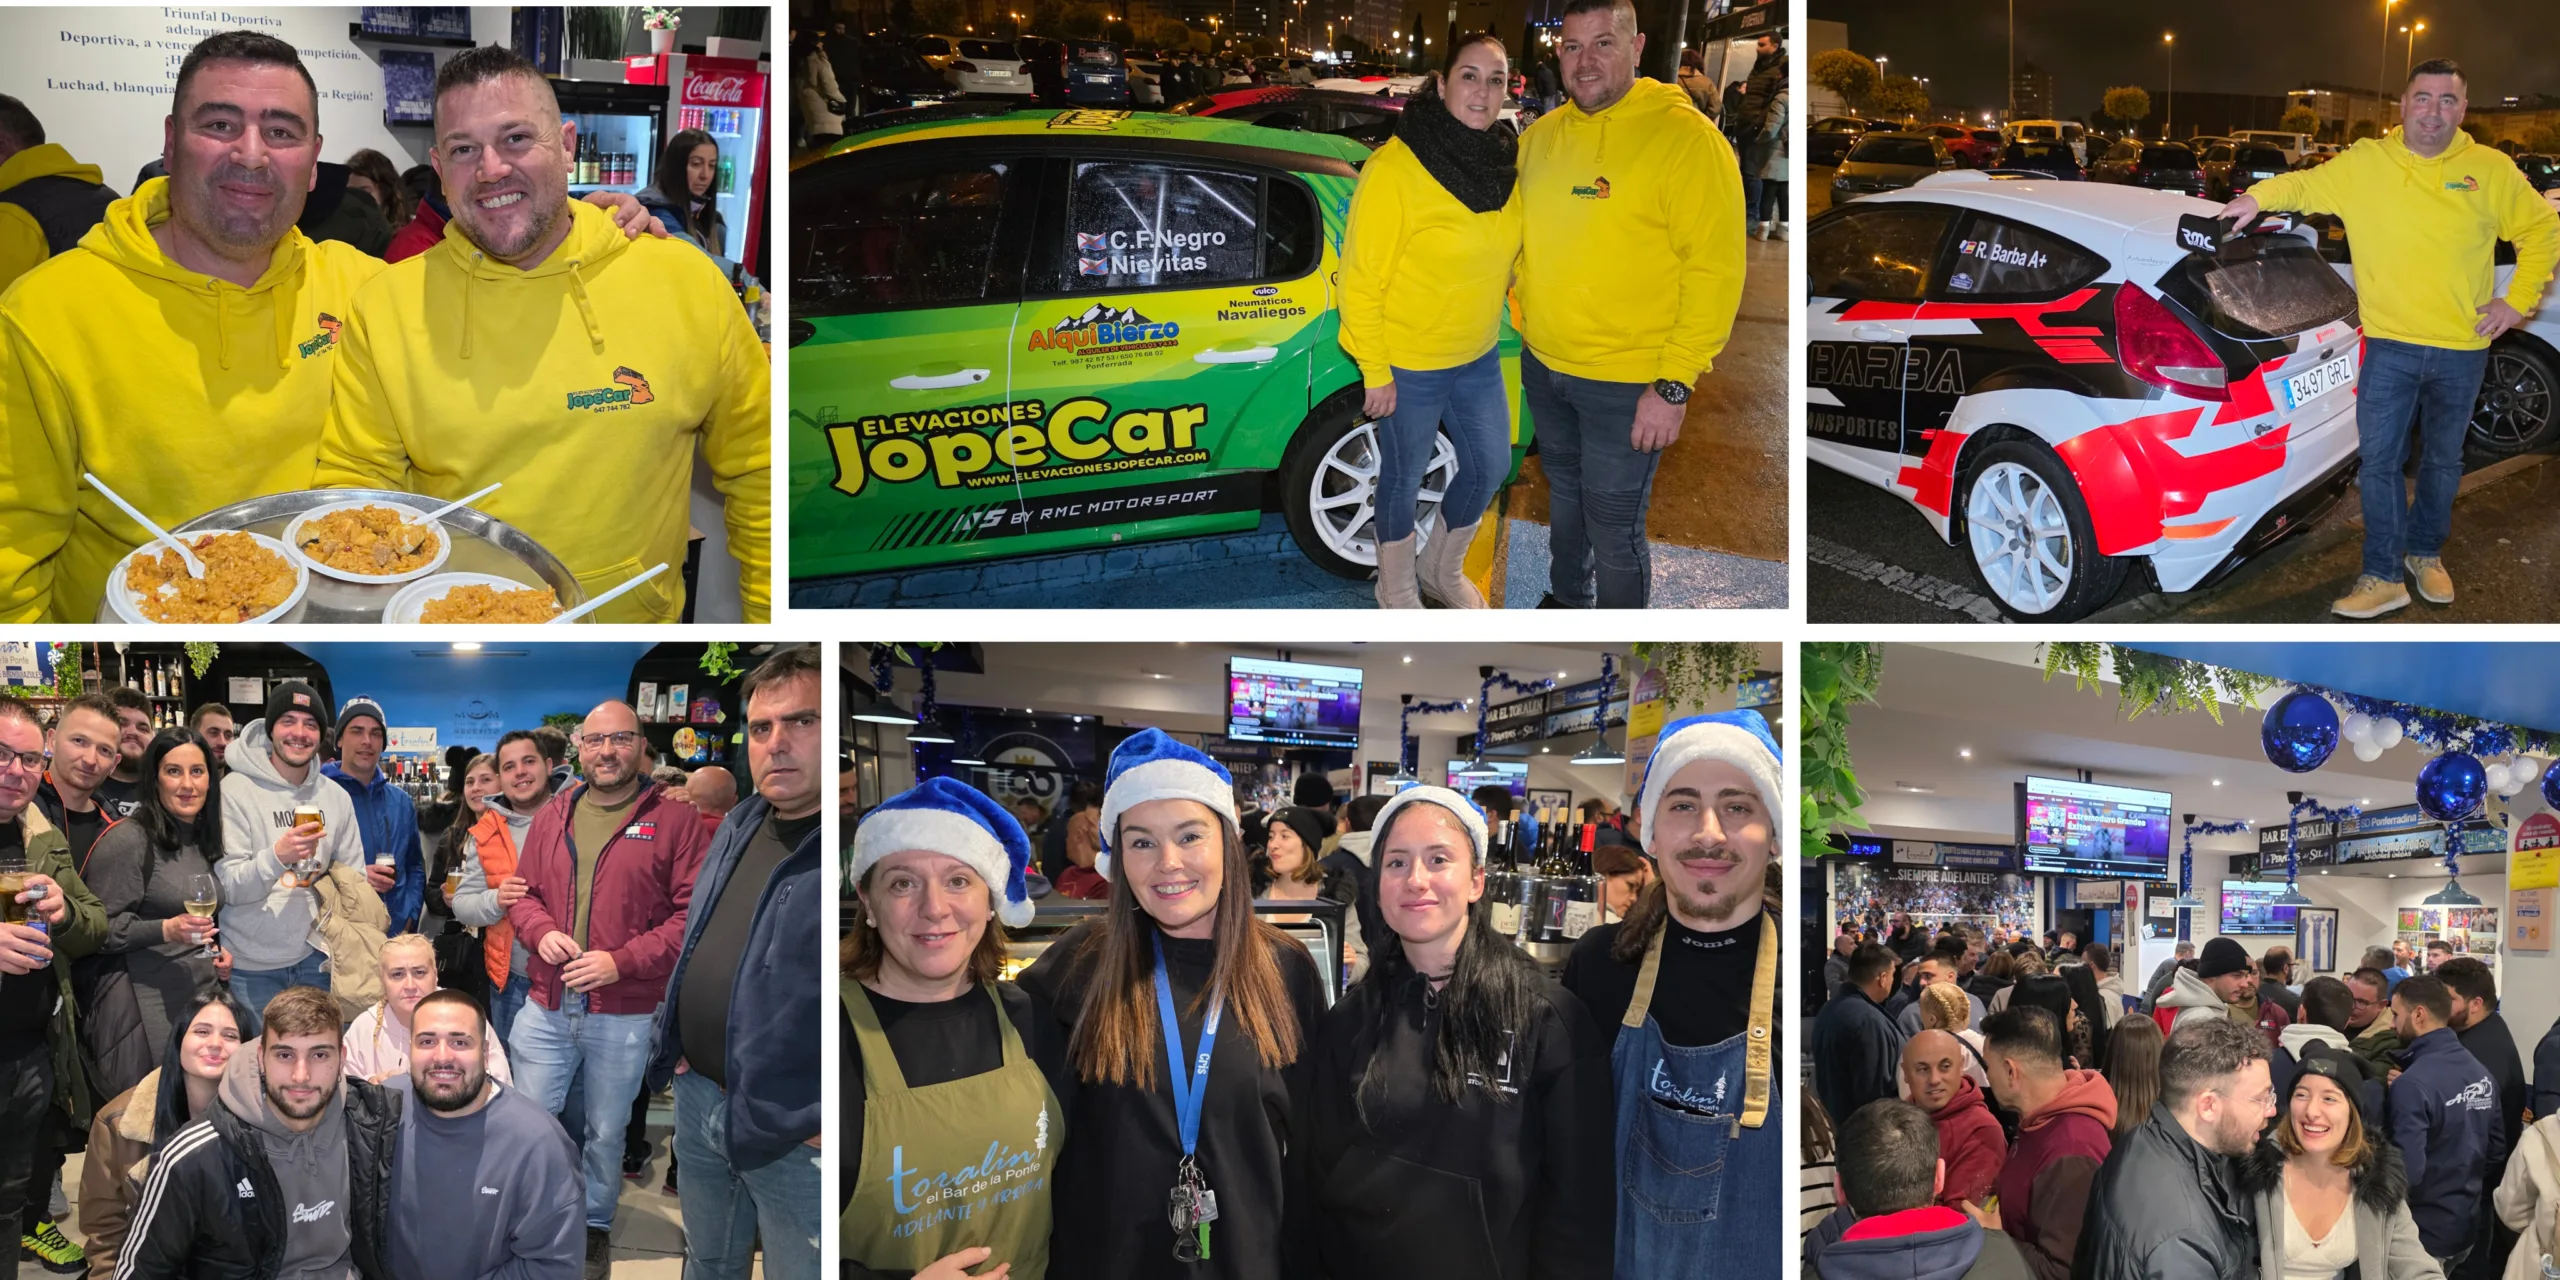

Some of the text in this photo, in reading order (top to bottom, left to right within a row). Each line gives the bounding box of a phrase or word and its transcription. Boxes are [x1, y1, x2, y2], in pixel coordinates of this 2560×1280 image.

[161, 7, 283, 27] Triunfal Deportiva
[60, 30, 140, 48] Deportiva,
[143, 40, 152, 48] a
[166, 23, 216, 38] adelant
[296, 46, 362, 61] ompetición.
[47, 77, 175, 96] Luchad, blanquia
[332, 89, 374, 102] Región!
[1111, 254, 1207, 275] Nievitas
[1975, 241, 2048, 269] R. Barba A+
[1217, 306, 1306, 321] Navaliegos
[1229, 297, 1293, 308] Neumáticos
[1028, 320, 1180, 353] AlquiBierzo
[1085, 360, 1133, 370] Ponferrada
[1809, 344, 1965, 394] BARBA
[2293, 358, 2350, 402] 3497 GRZ
[567, 388, 631, 410] JopeCar
[863, 403, 1042, 437] ELEVACIONES
[1807, 411, 1898, 440] ANSPORTES
[828, 399, 1205, 495] JopeCar
[967, 451, 1207, 487] WWW.ELEVACIONESJOPECAR.COM
[1010, 509, 1034, 525] BY
[1040, 504, 1082, 520] RMC
[1087, 488, 1218, 514] MOTORSPORT
[2067, 812, 2146, 827] Extremoduro Grandes
[2371, 813, 2417, 827] Ponferradina
[2261, 830, 2279, 844] BAR
[2297, 822, 2334, 839] ORALIN
[1197, 1053, 1210, 1075] Cris
[926, 1163, 1040, 1204] el Bar de la Ponfe
[893, 1203, 973, 1238] ADELANTE
